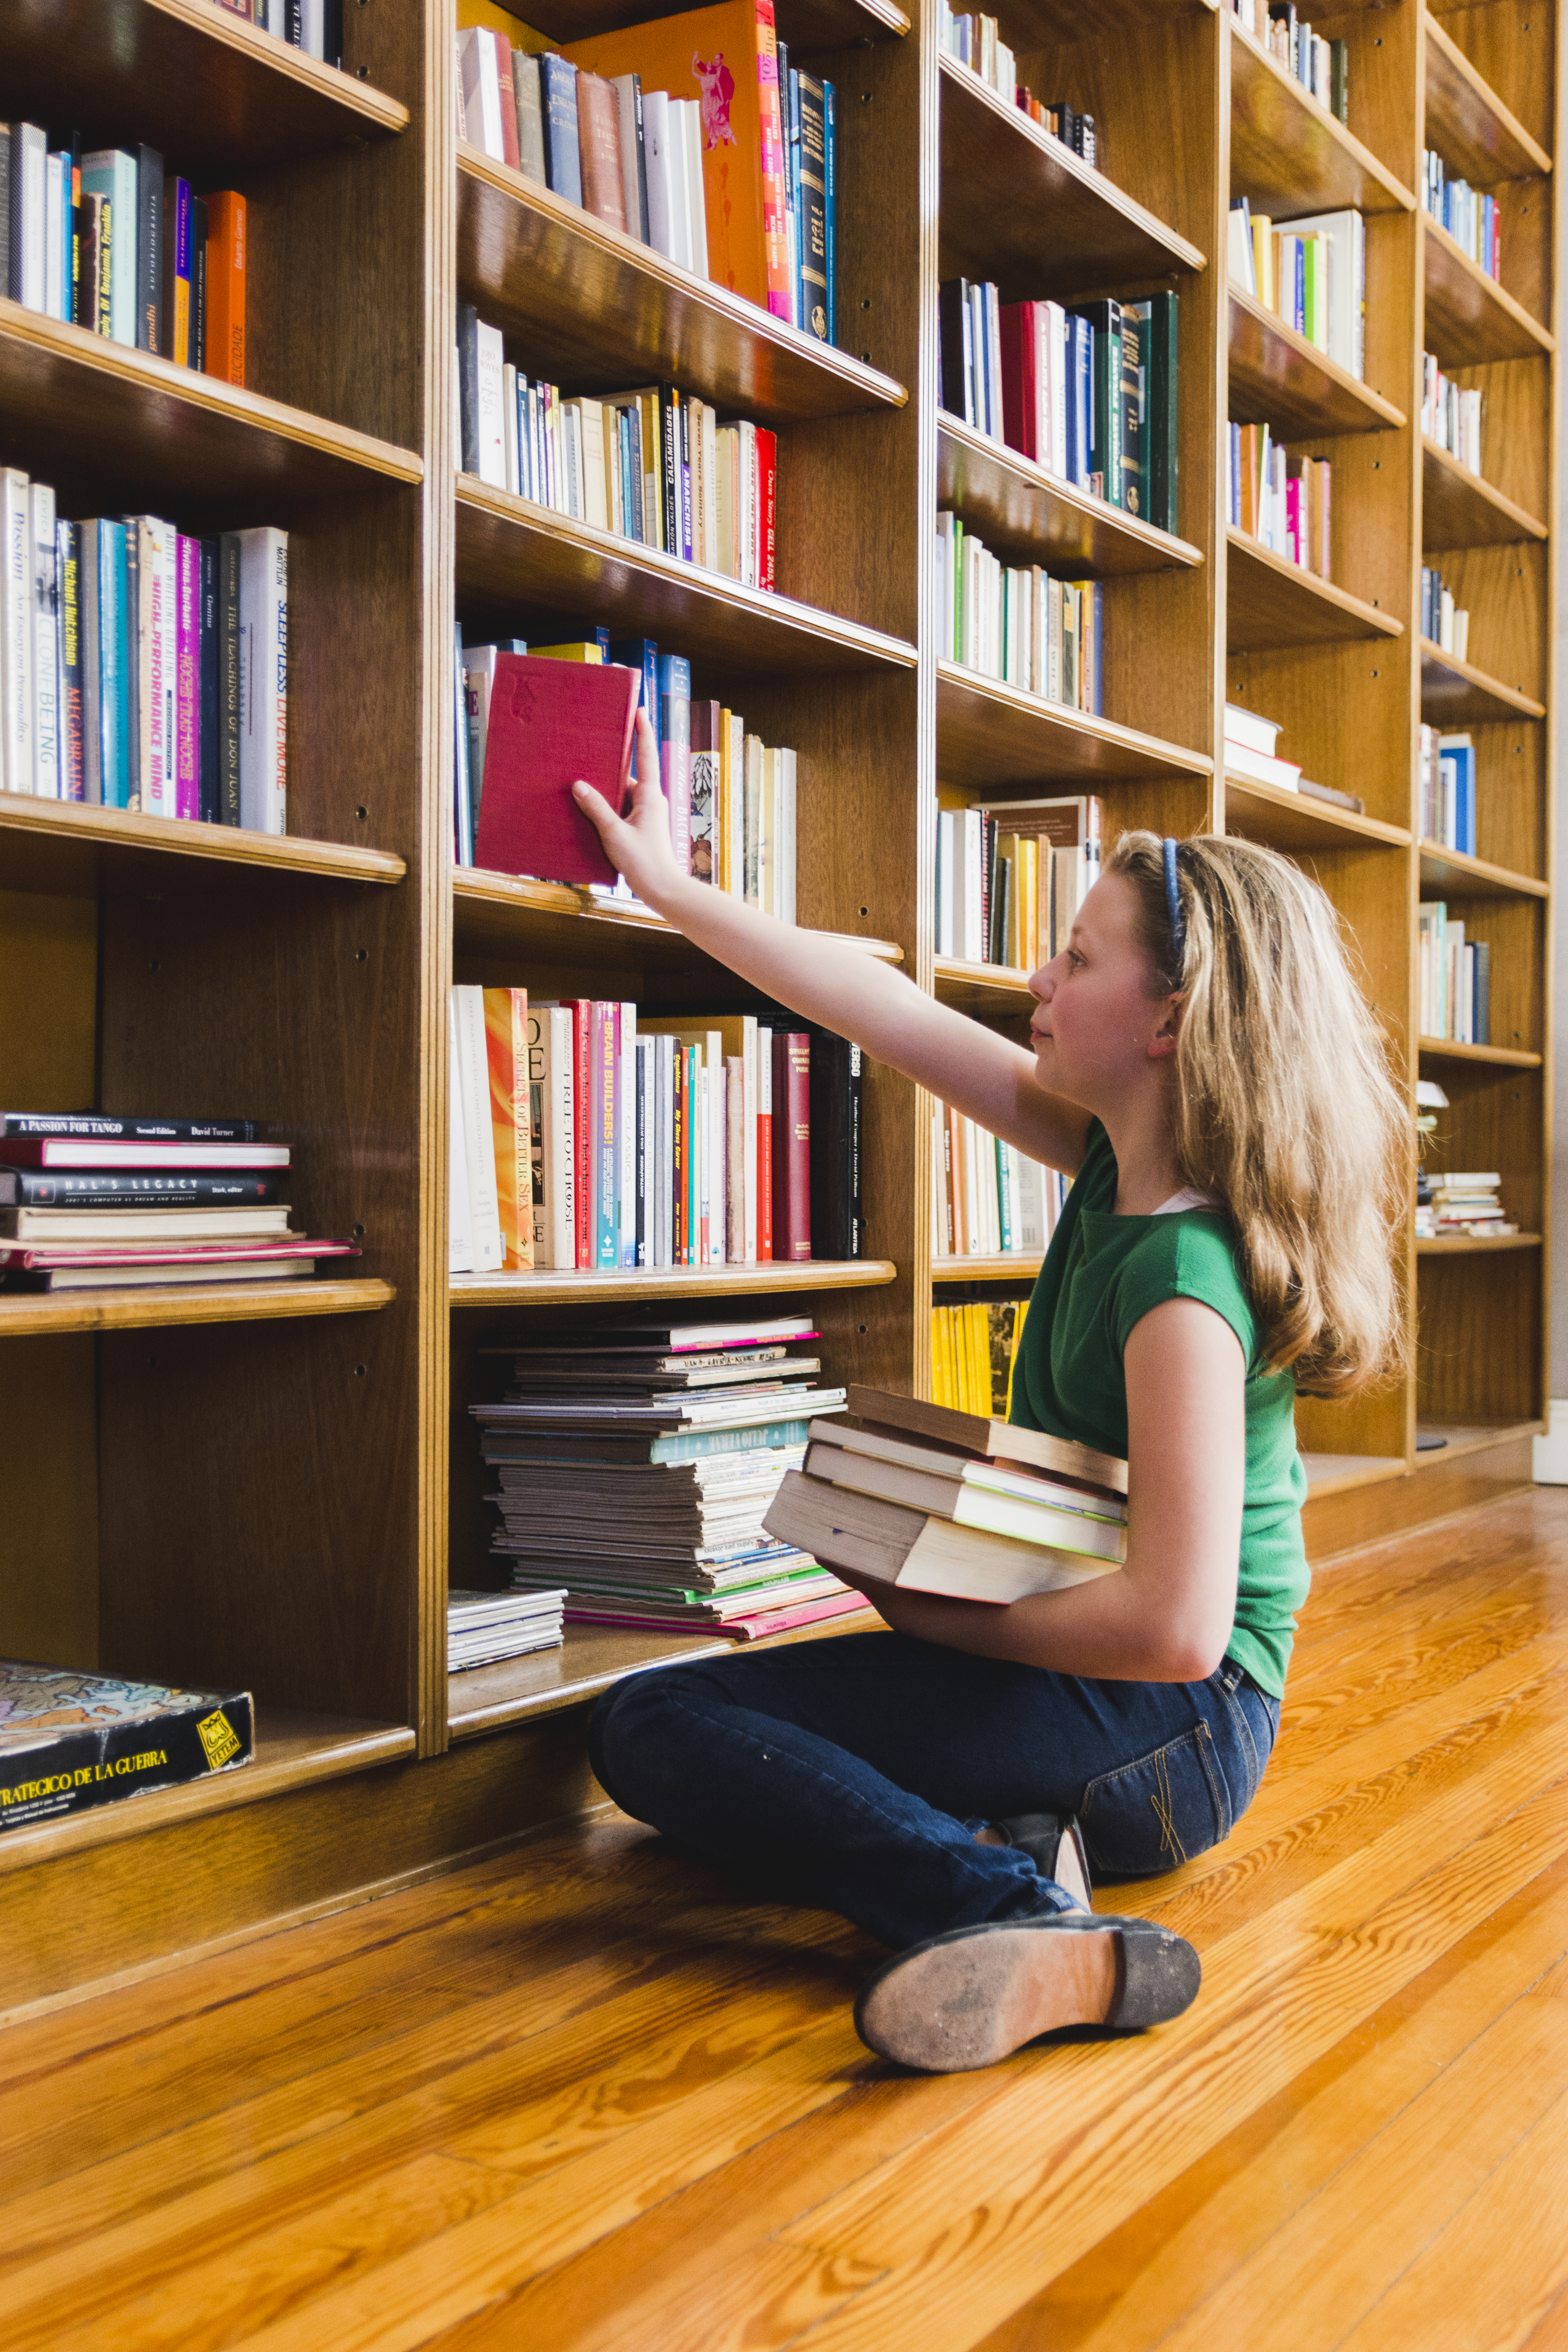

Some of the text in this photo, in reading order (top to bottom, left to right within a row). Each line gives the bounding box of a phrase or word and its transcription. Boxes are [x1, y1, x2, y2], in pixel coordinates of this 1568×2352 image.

[101, 204, 112, 245] Franklin
[235, 207, 243, 239] Giannetti
[100, 244, 111, 294] Benjamin
[148, 304, 157, 352] gandhi
[232, 324, 243, 386] ELICIDADE
[165, 533, 174, 624] ADLER WHEELING
[182, 539, 191, 584] Viviana
[14, 510, 26, 743] Passion An Essay on Personality
[63, 559, 77, 666] Michael Hutchison
[277, 600, 287, 652] SLEEP
[180, 654, 193, 781] NOCHE TRAS NOCHE
[228, 605, 237, 809] THE TEACHINGS OF DON JUAN
[276, 698, 287, 737] LIVE
[67, 686, 82, 795] MEGABRAIN
[150, 754, 162, 801] MIND
[276, 741, 286, 791] MORE
[676, 806, 688, 839] BACH
[473, 1069, 478, 1083] OF
[604, 1021, 614, 1144] BRAIN BUILDERS!
[19, 1121, 27, 1131] A
[28, 1121, 67, 1132] PASSION
[69, 1121, 89, 1132] FOR
[91, 1122, 122, 1133] TANGO
[191, 1126, 211, 1136] David
[212, 1127, 234, 1136] Turner
[474, 1087, 485, 1175] CONSCIOUSNESS
[516, 1042, 531, 1211] SECRETS OF BETTER SEX
[675, 1109, 681, 1121] My
[564, 1131, 572, 1155] TO
[624, 1116, 632, 1182] CLASSICS
[65, 1180, 118, 1190] HAL'S
[132, 1179, 198, 1189] LEGACY
[564, 1158, 573, 1230] CHOOSE
[75, 1767, 93, 1787] DE
[95, 1762, 114, 1781] LA
[116, 1749, 168, 1774] GUERRA
[211, 1735, 239, 1764] YETEM
